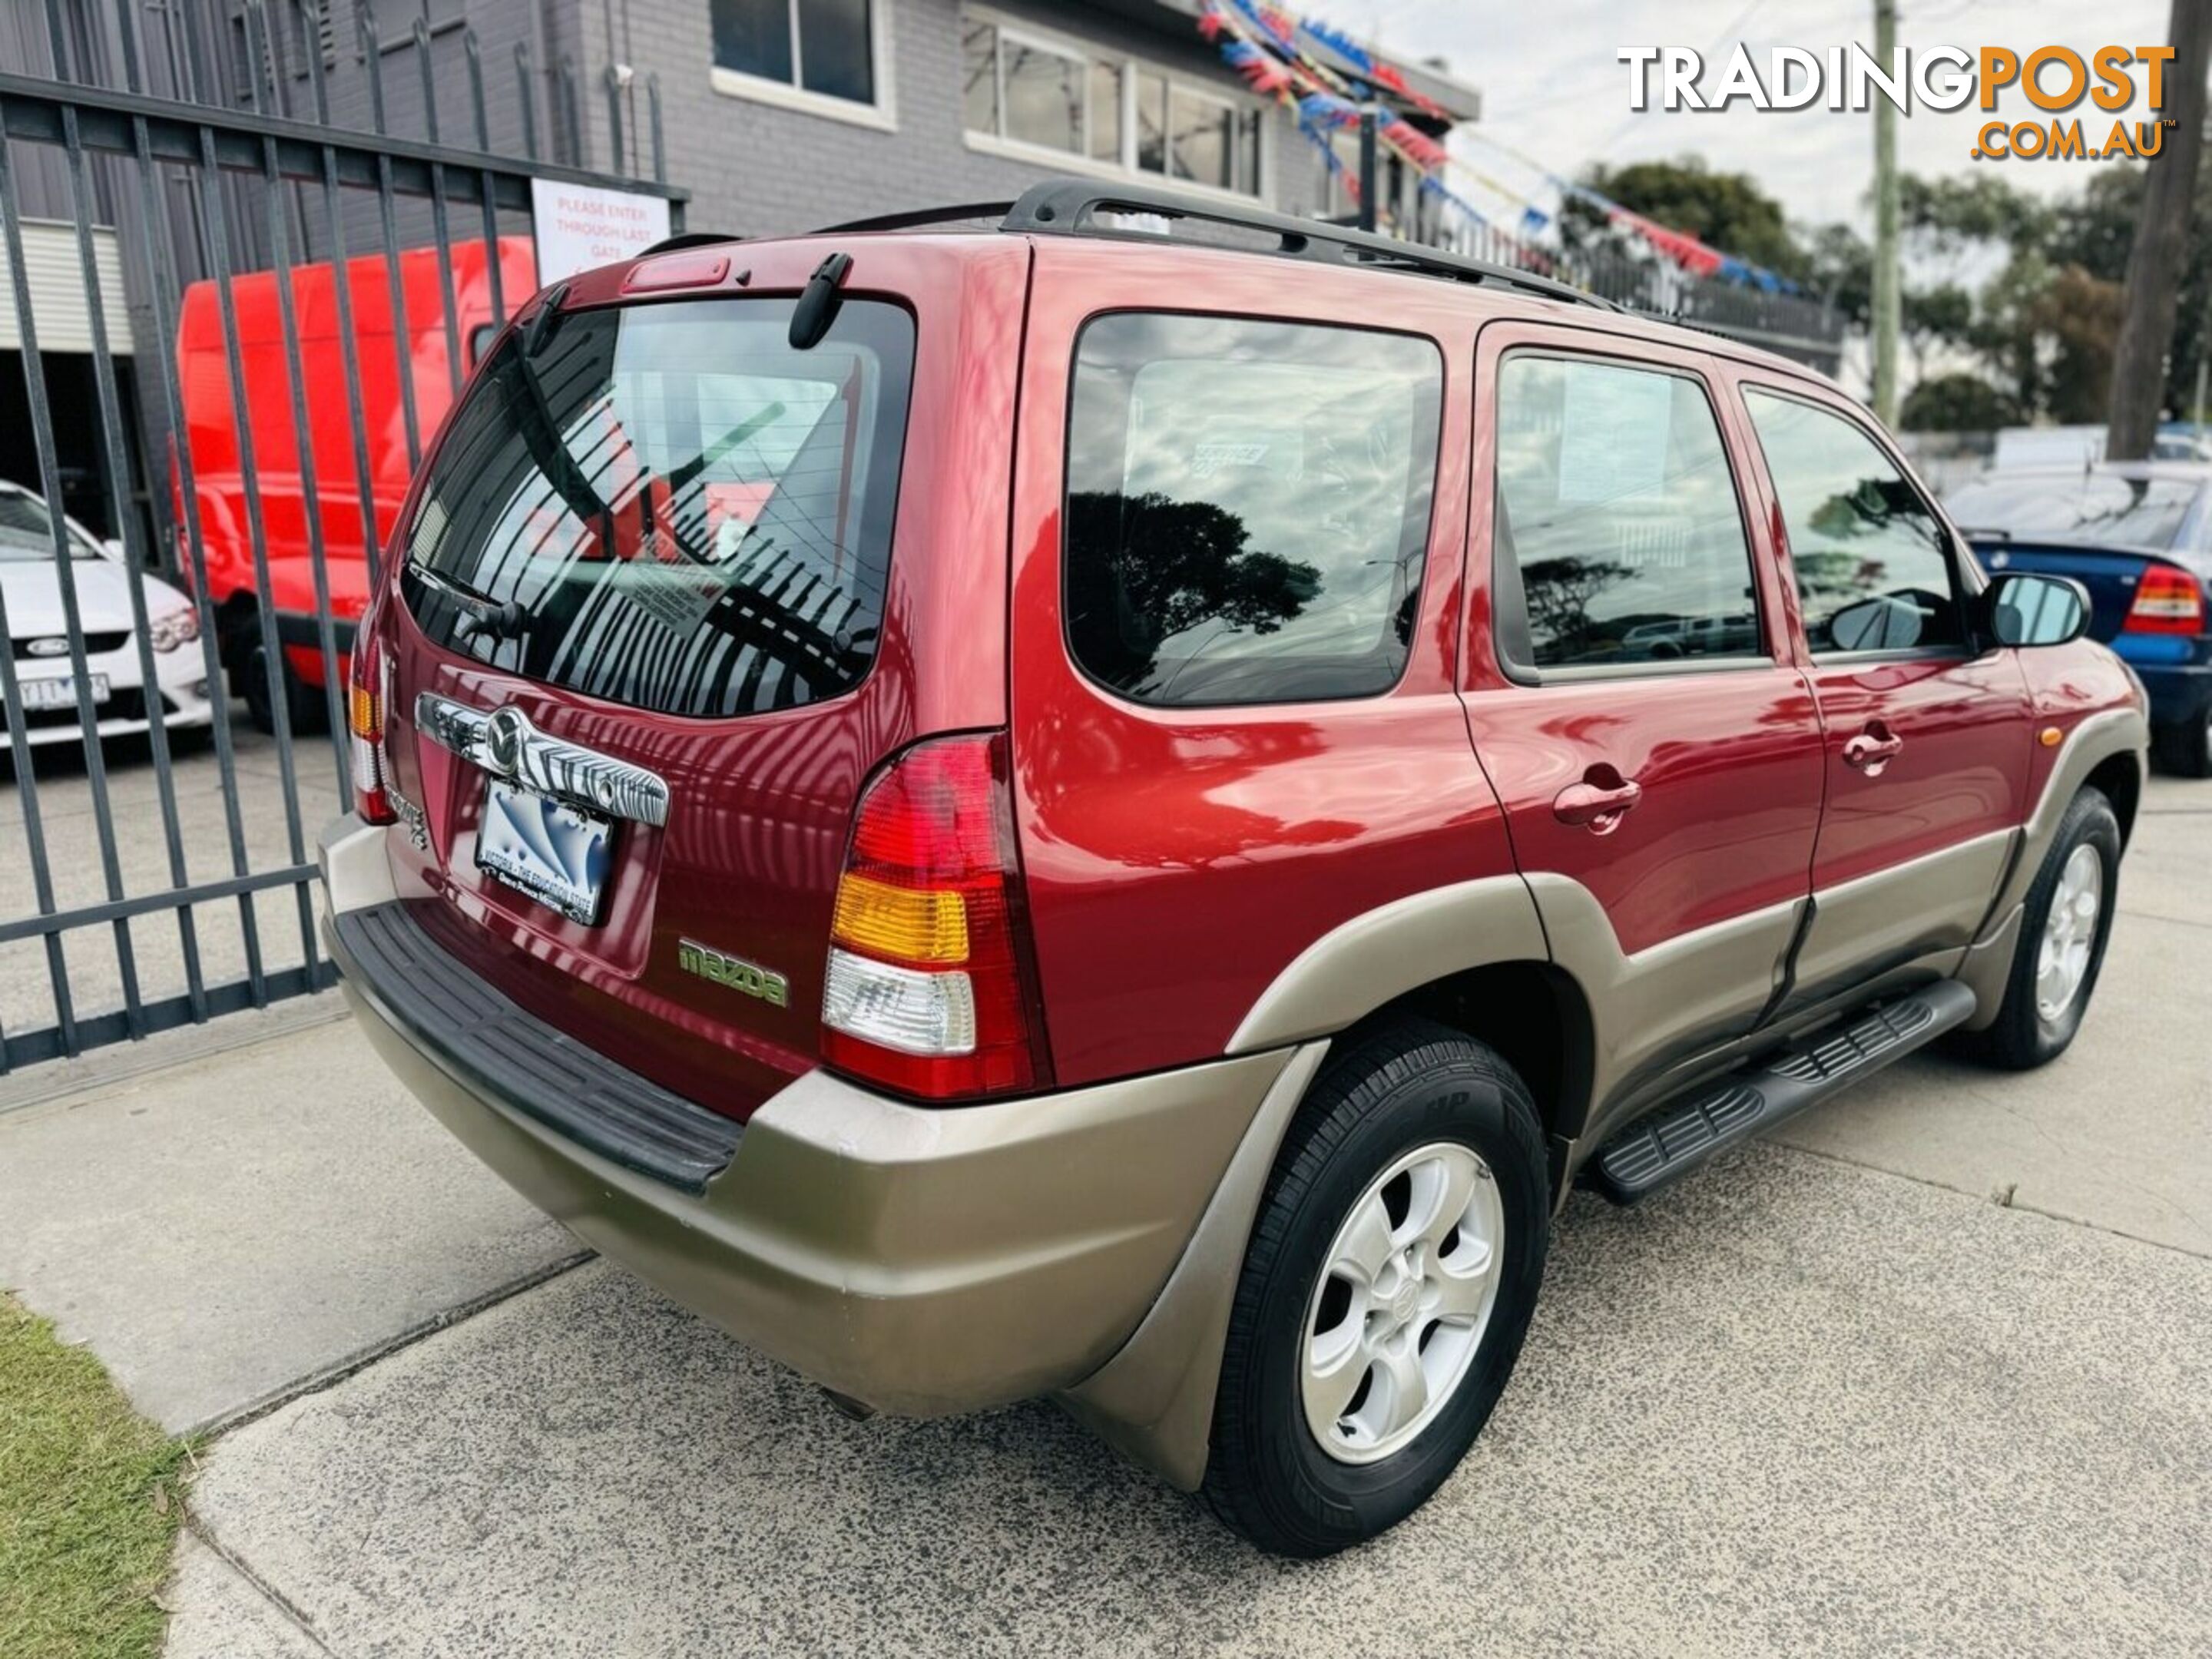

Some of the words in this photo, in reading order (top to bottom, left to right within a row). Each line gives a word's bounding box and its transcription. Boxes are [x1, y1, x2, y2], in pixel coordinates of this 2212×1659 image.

[558, 197, 604, 217] PLEASE
[608, 204, 647, 222] ENTER
[557, 219, 620, 238] THROUGH
[622, 228, 651, 243] LAST
[591, 243, 621, 260] GATE
[679, 938, 787, 1008] mazda
